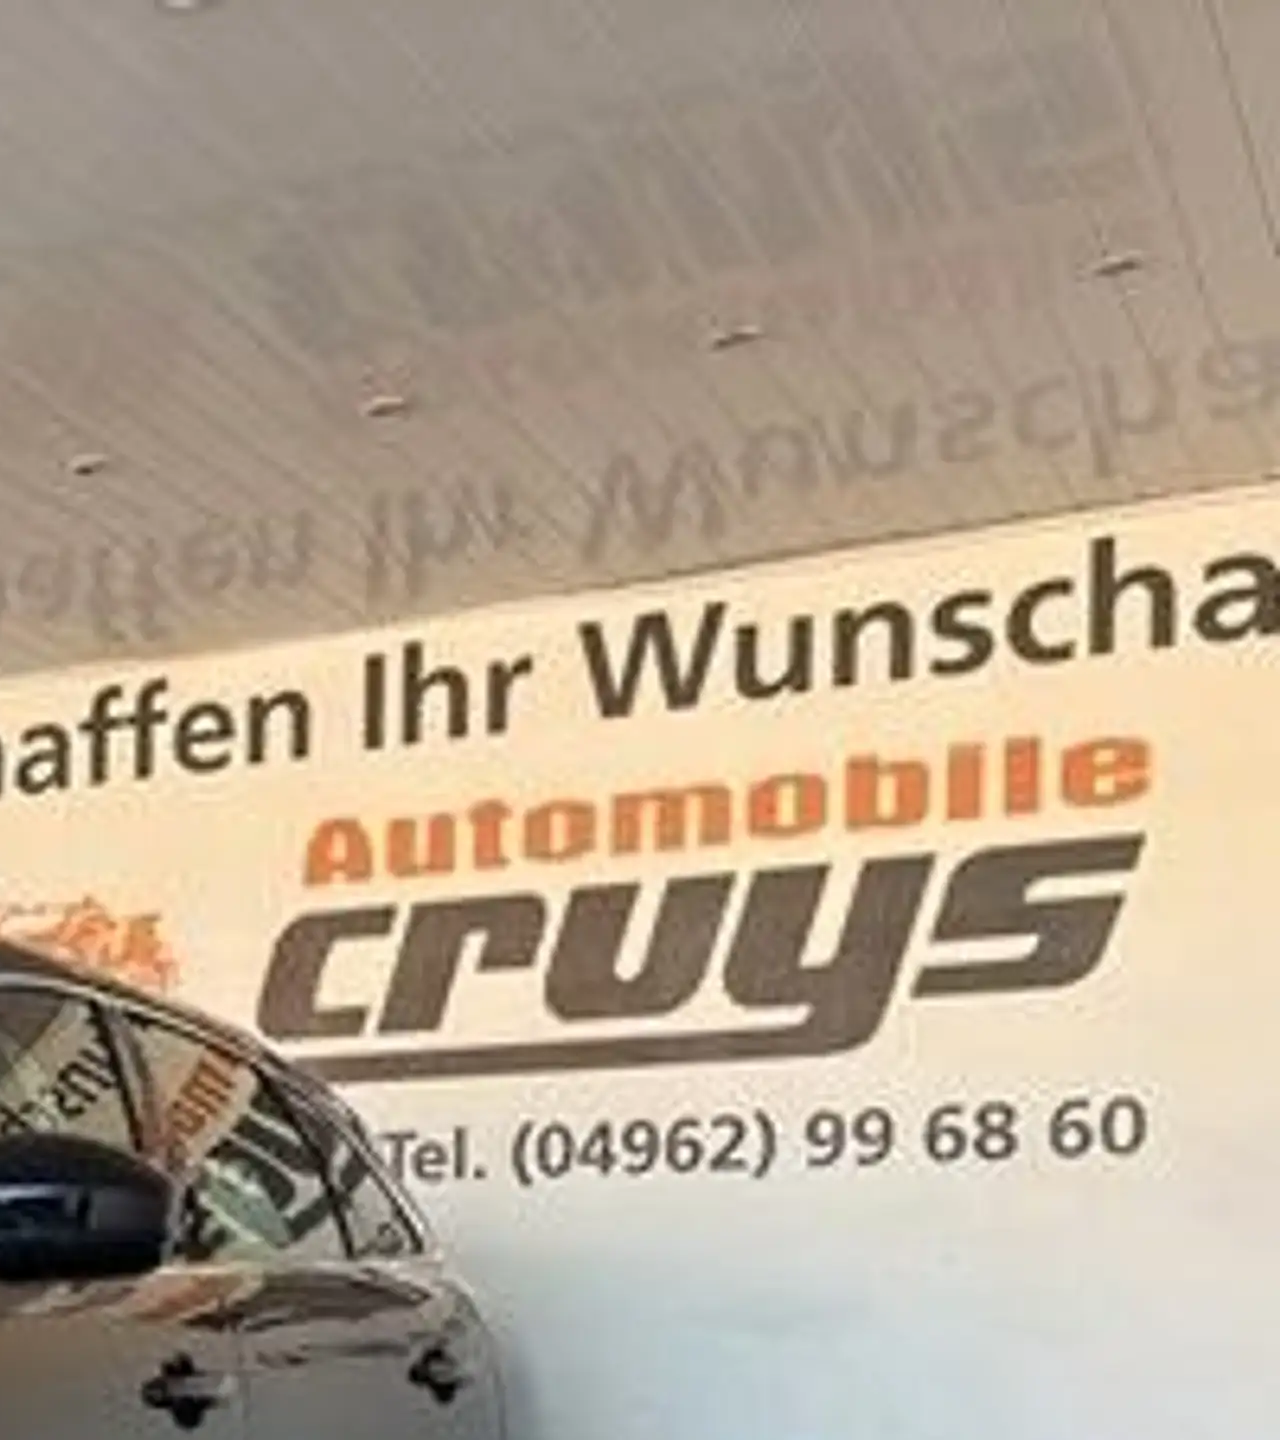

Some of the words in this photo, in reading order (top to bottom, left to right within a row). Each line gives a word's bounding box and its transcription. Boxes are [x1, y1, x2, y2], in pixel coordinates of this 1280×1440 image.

[362, 640, 534, 750] Ihr
[579, 535, 1280, 720] Wunscha
[302, 735, 1152, 886] Automobile
[257, 832, 1147, 1056] cruys
[380, 1125, 487, 1185] Tel.
[510, 1111, 777, 1189] (04962)
[806, 1109, 894, 1168] 99
[925, 1101, 1018, 1163] 68
[1049, 1096, 1148, 1158] 60
